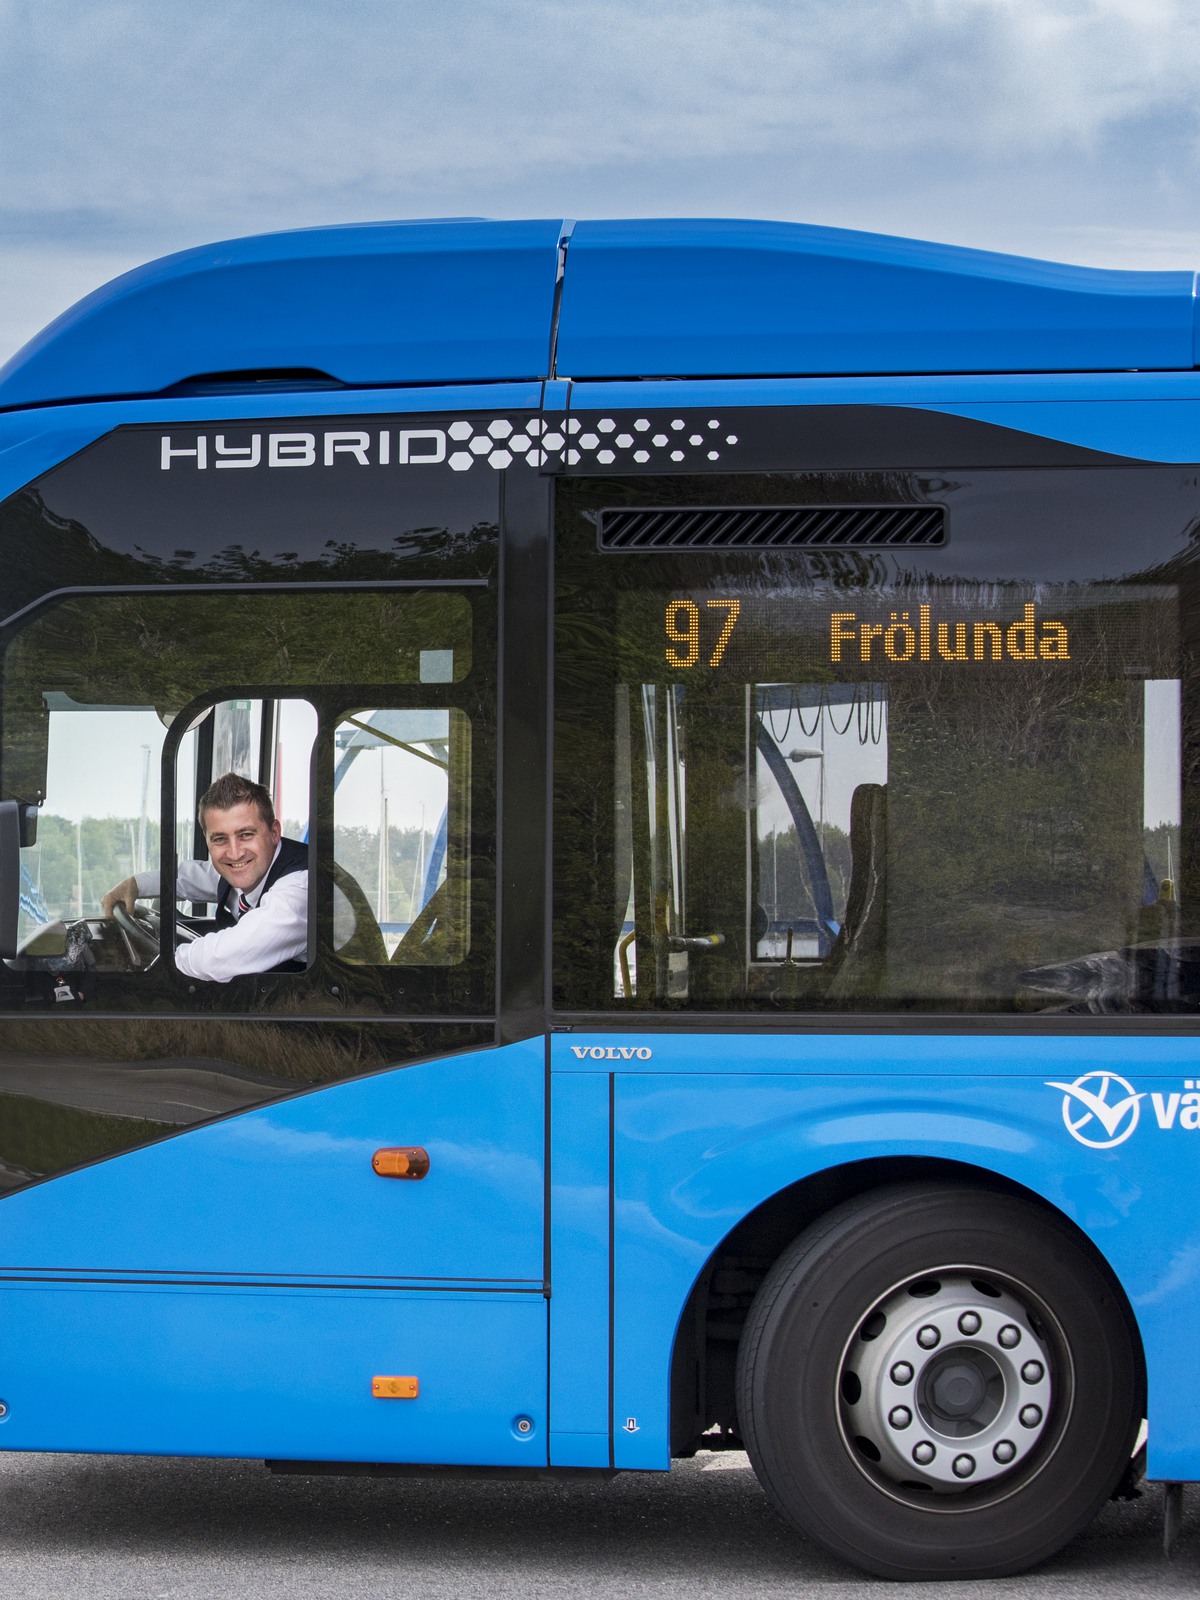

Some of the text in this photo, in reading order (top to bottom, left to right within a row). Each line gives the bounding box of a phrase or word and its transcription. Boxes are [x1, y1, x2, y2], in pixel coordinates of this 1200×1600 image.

[161, 430, 447, 469] HYBRID
[665, 599, 1071, 668] 97 Frölunda
[571, 1046, 653, 1060] VOLVO
